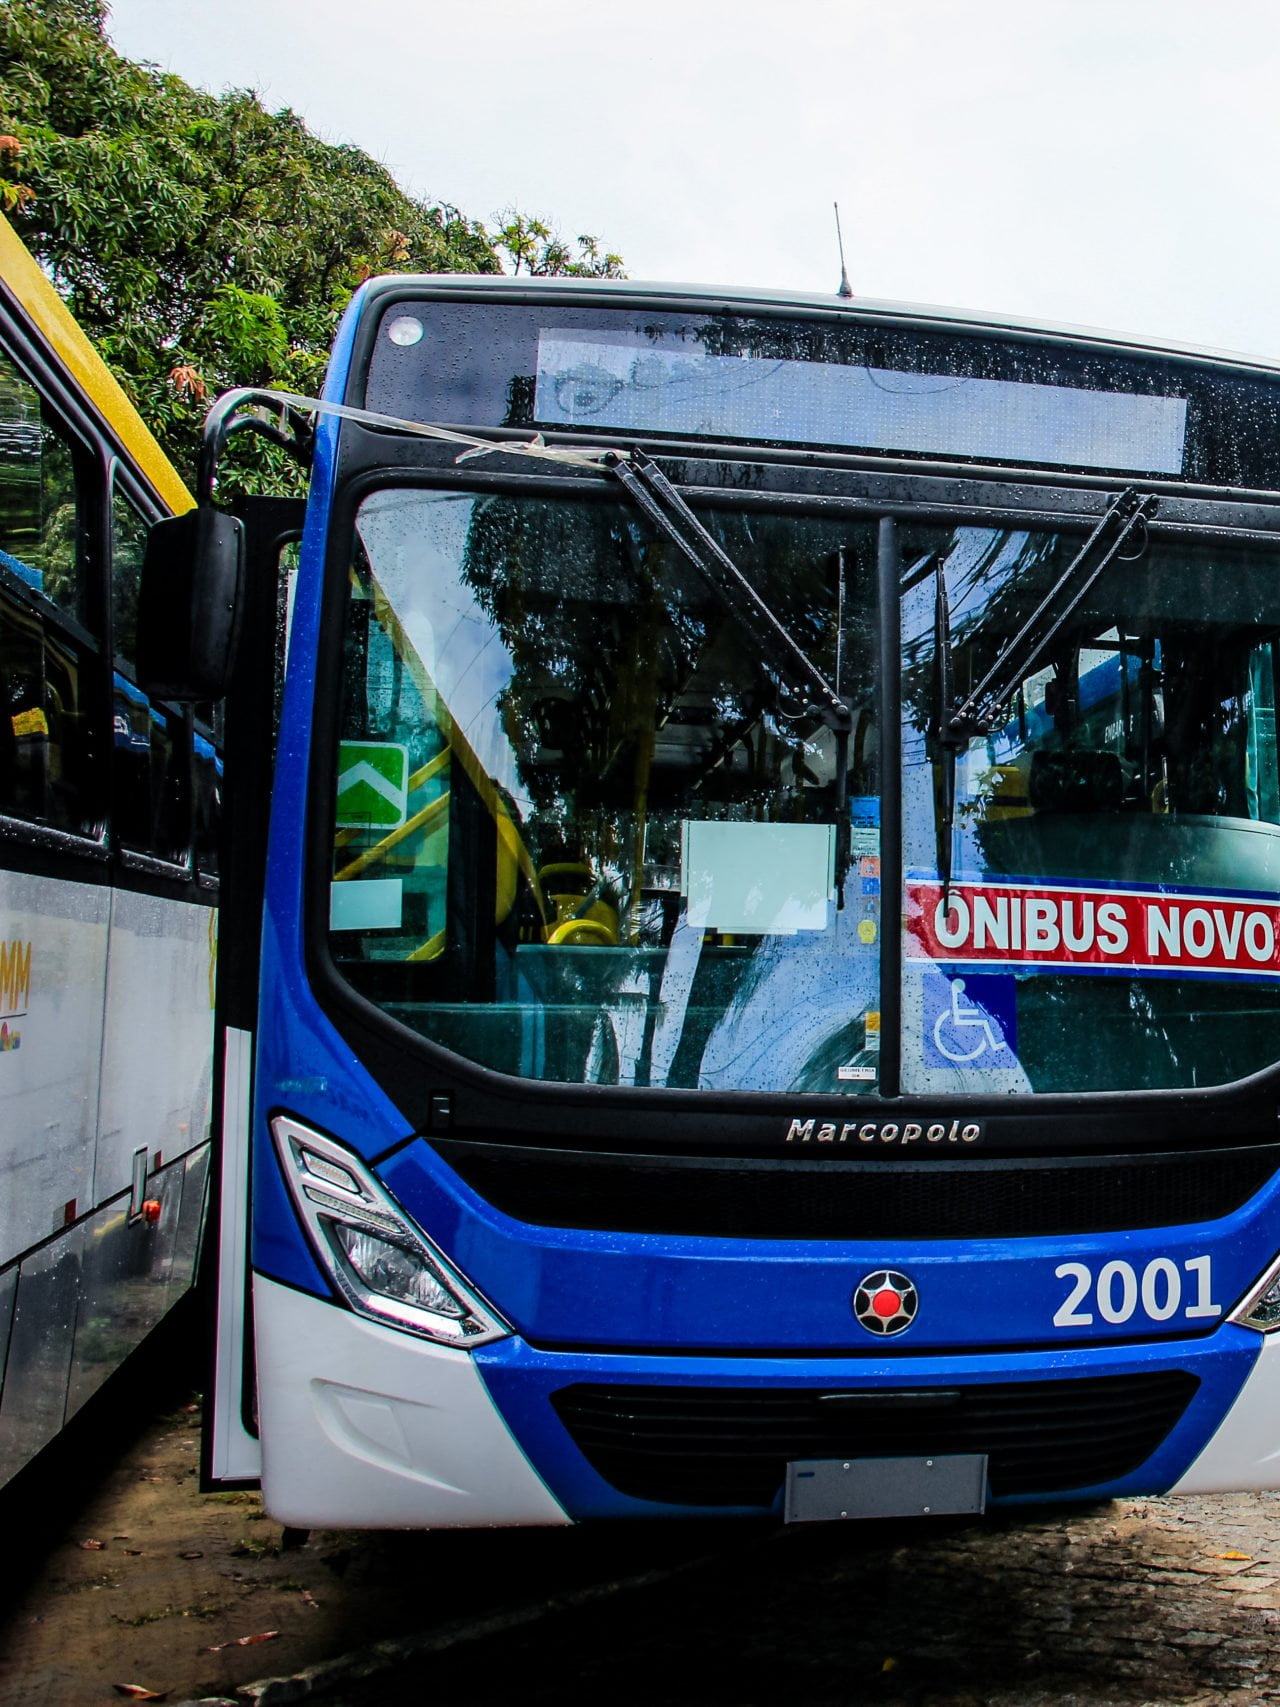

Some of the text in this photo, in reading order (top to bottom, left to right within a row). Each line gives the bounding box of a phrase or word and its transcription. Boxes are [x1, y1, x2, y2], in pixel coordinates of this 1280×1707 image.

[934, 889, 1275, 962] ÔNIBUS NOVO
[786, 1118, 981, 1144] Marcopolo
[1053, 1254, 1222, 1327] 2001
